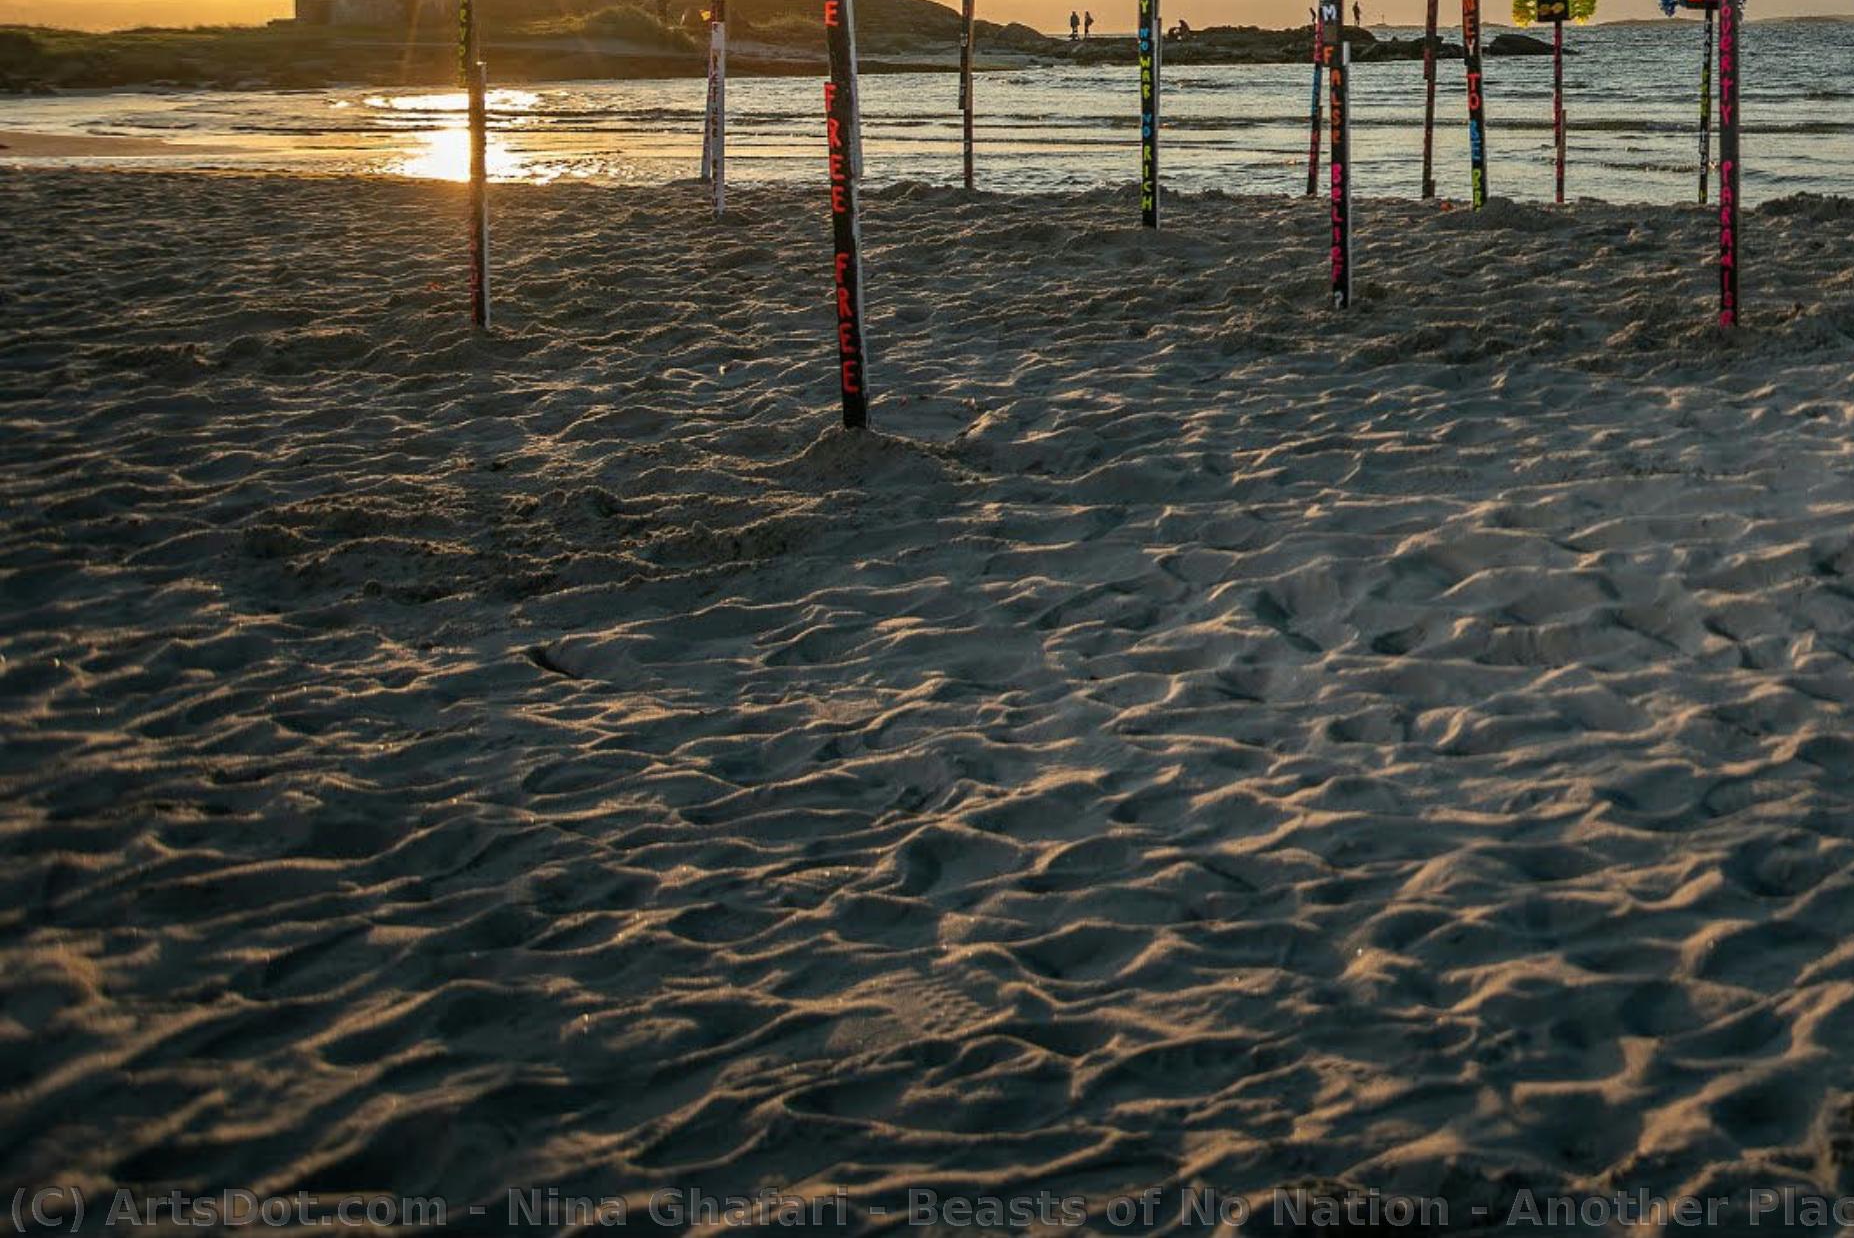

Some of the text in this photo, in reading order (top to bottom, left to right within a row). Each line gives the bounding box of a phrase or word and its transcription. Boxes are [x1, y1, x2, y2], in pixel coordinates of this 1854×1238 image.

[1140, 56, 1151, 100] WAR
[1467, 73, 1481, 110] TO
[825, 82, 849, 213] FREE
[1141, 145, 1152, 211] RICH
[835, 252, 860, 394] FREE
